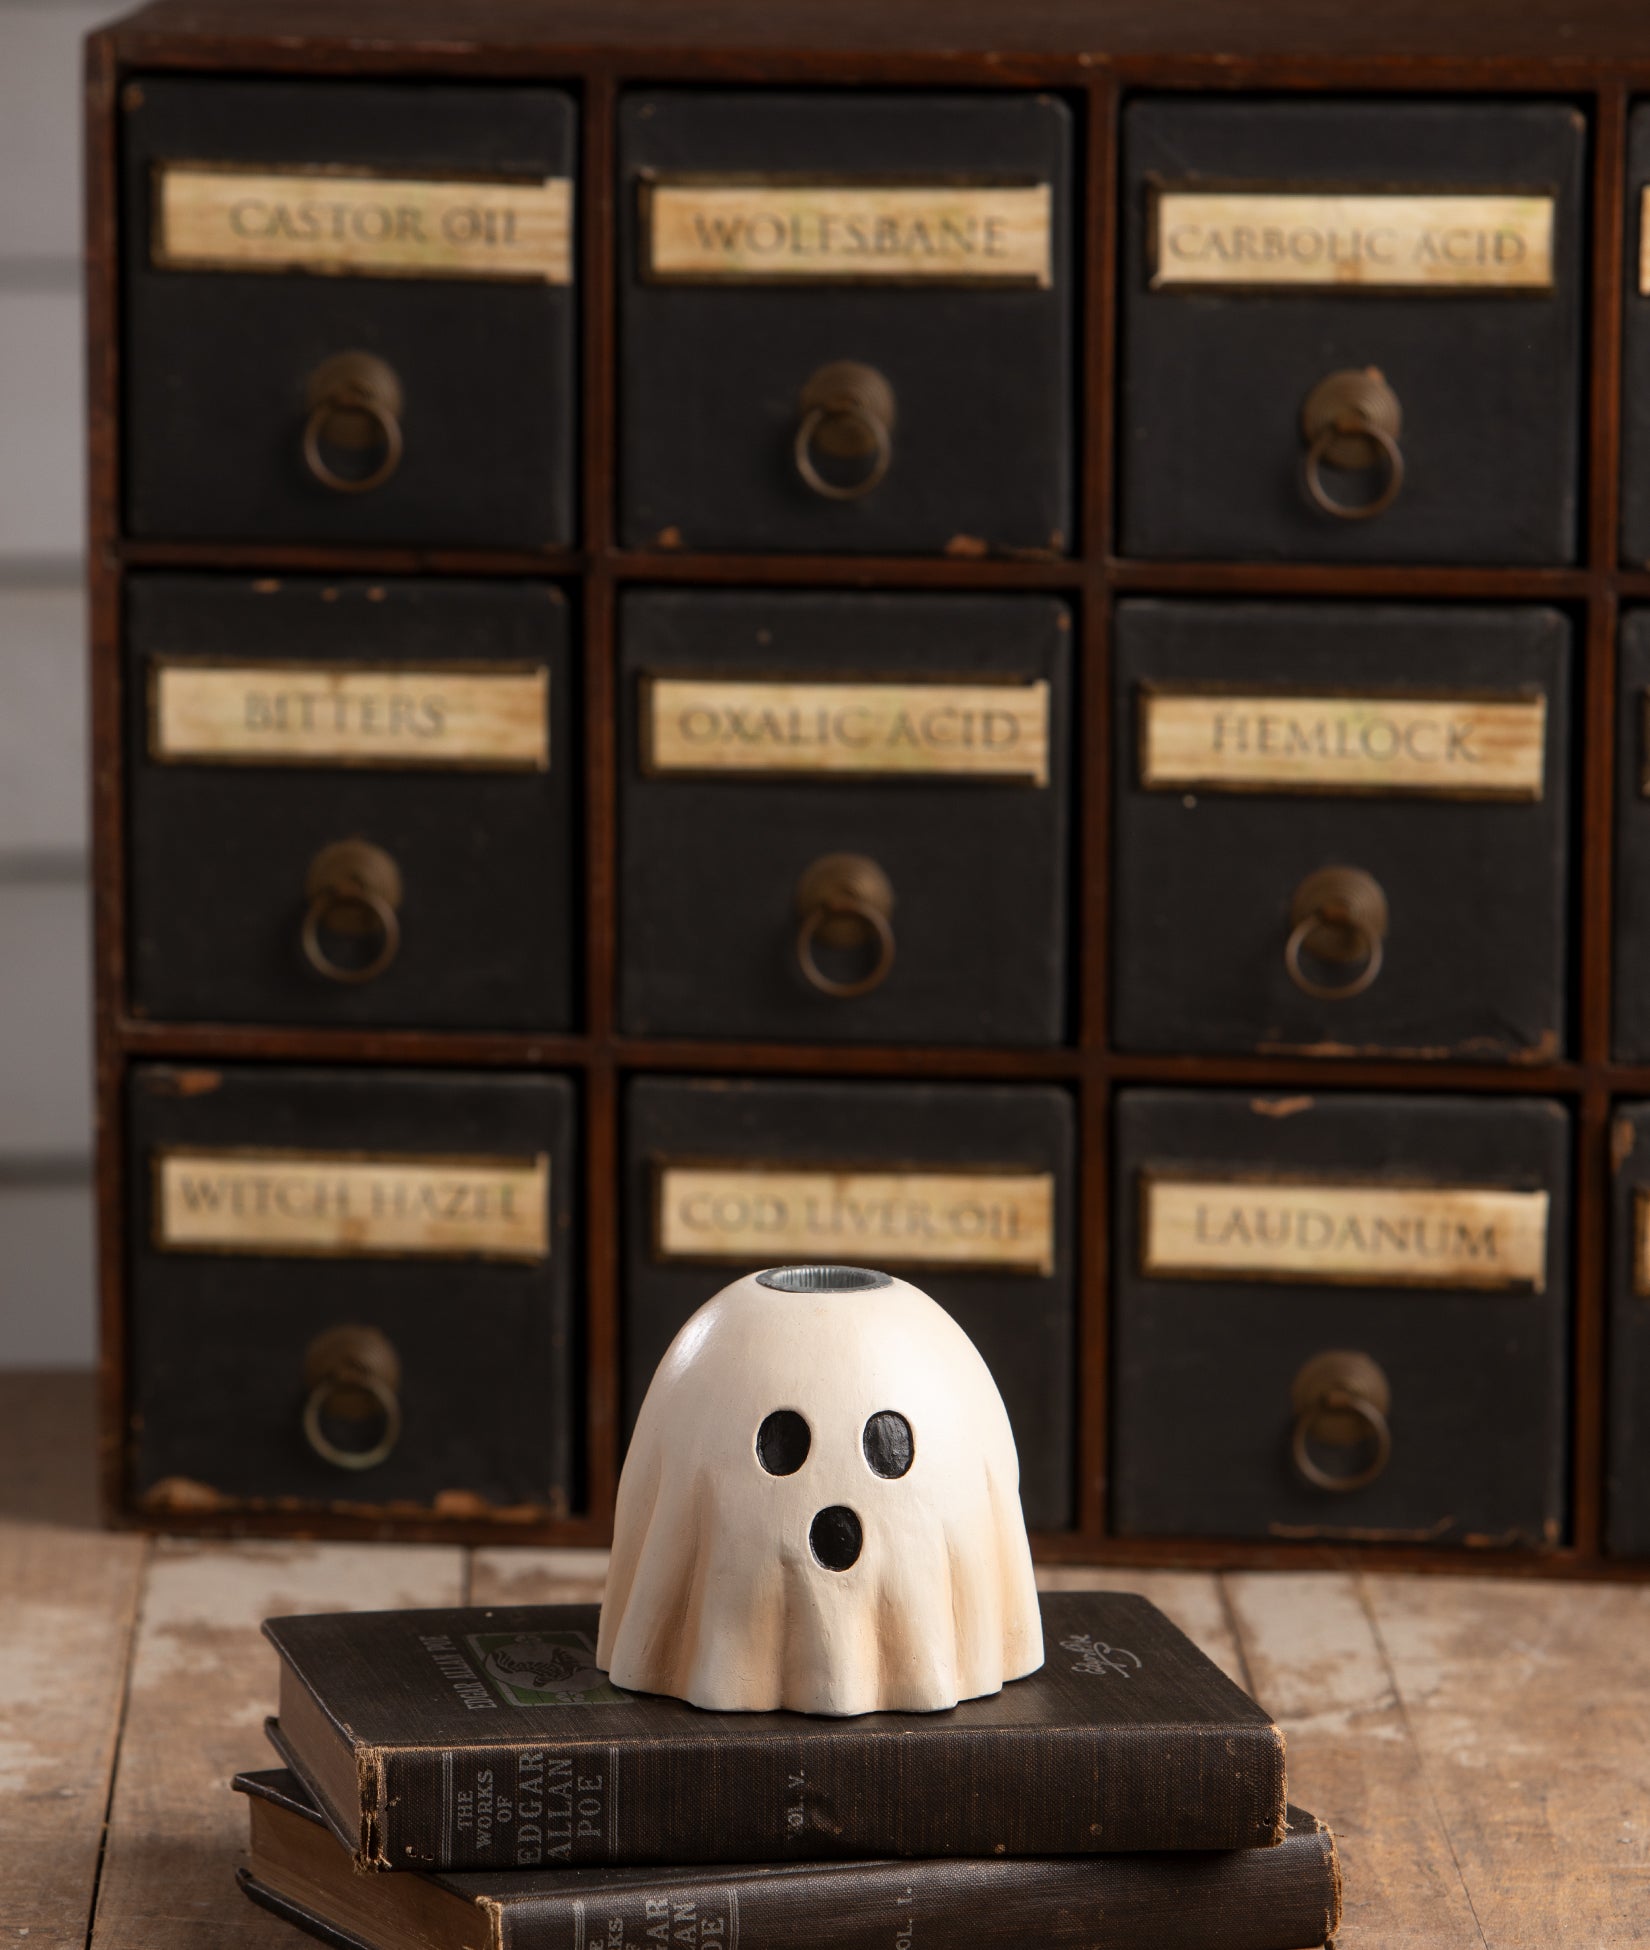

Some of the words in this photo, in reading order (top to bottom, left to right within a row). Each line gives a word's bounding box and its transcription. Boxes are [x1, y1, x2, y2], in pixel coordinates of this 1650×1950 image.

[229, 197, 428, 245] CASTOR
[693, 211, 1011, 259] WOLFSBANE
[1167, 222, 1397, 265] CARBOLIC
[1413, 229, 1527, 267] ACID
[244, 689, 447, 739] BITTERS
[679, 703, 870, 749] OXALIC
[886, 706, 1021, 753] ACID
[1212, 711, 1480, 764] HEMLOCK
[180, 1172, 349, 1218] WITCH
[371, 1179, 521, 1223] HAZEL
[678, 1190, 789, 1235] COD
[1195, 1204, 1499, 1260] LAUDANUM
[453, 1681, 498, 1710] EDGAR
[457, 1790, 473, 1830] THE
[476, 1769, 493, 1849] WORKS
[496, 1795, 512, 1823] OF
[518, 1751, 543, 1865] EDGAR
[547, 1758, 573, 1861] ALLAN
[577, 1775, 602, 1838] POE
